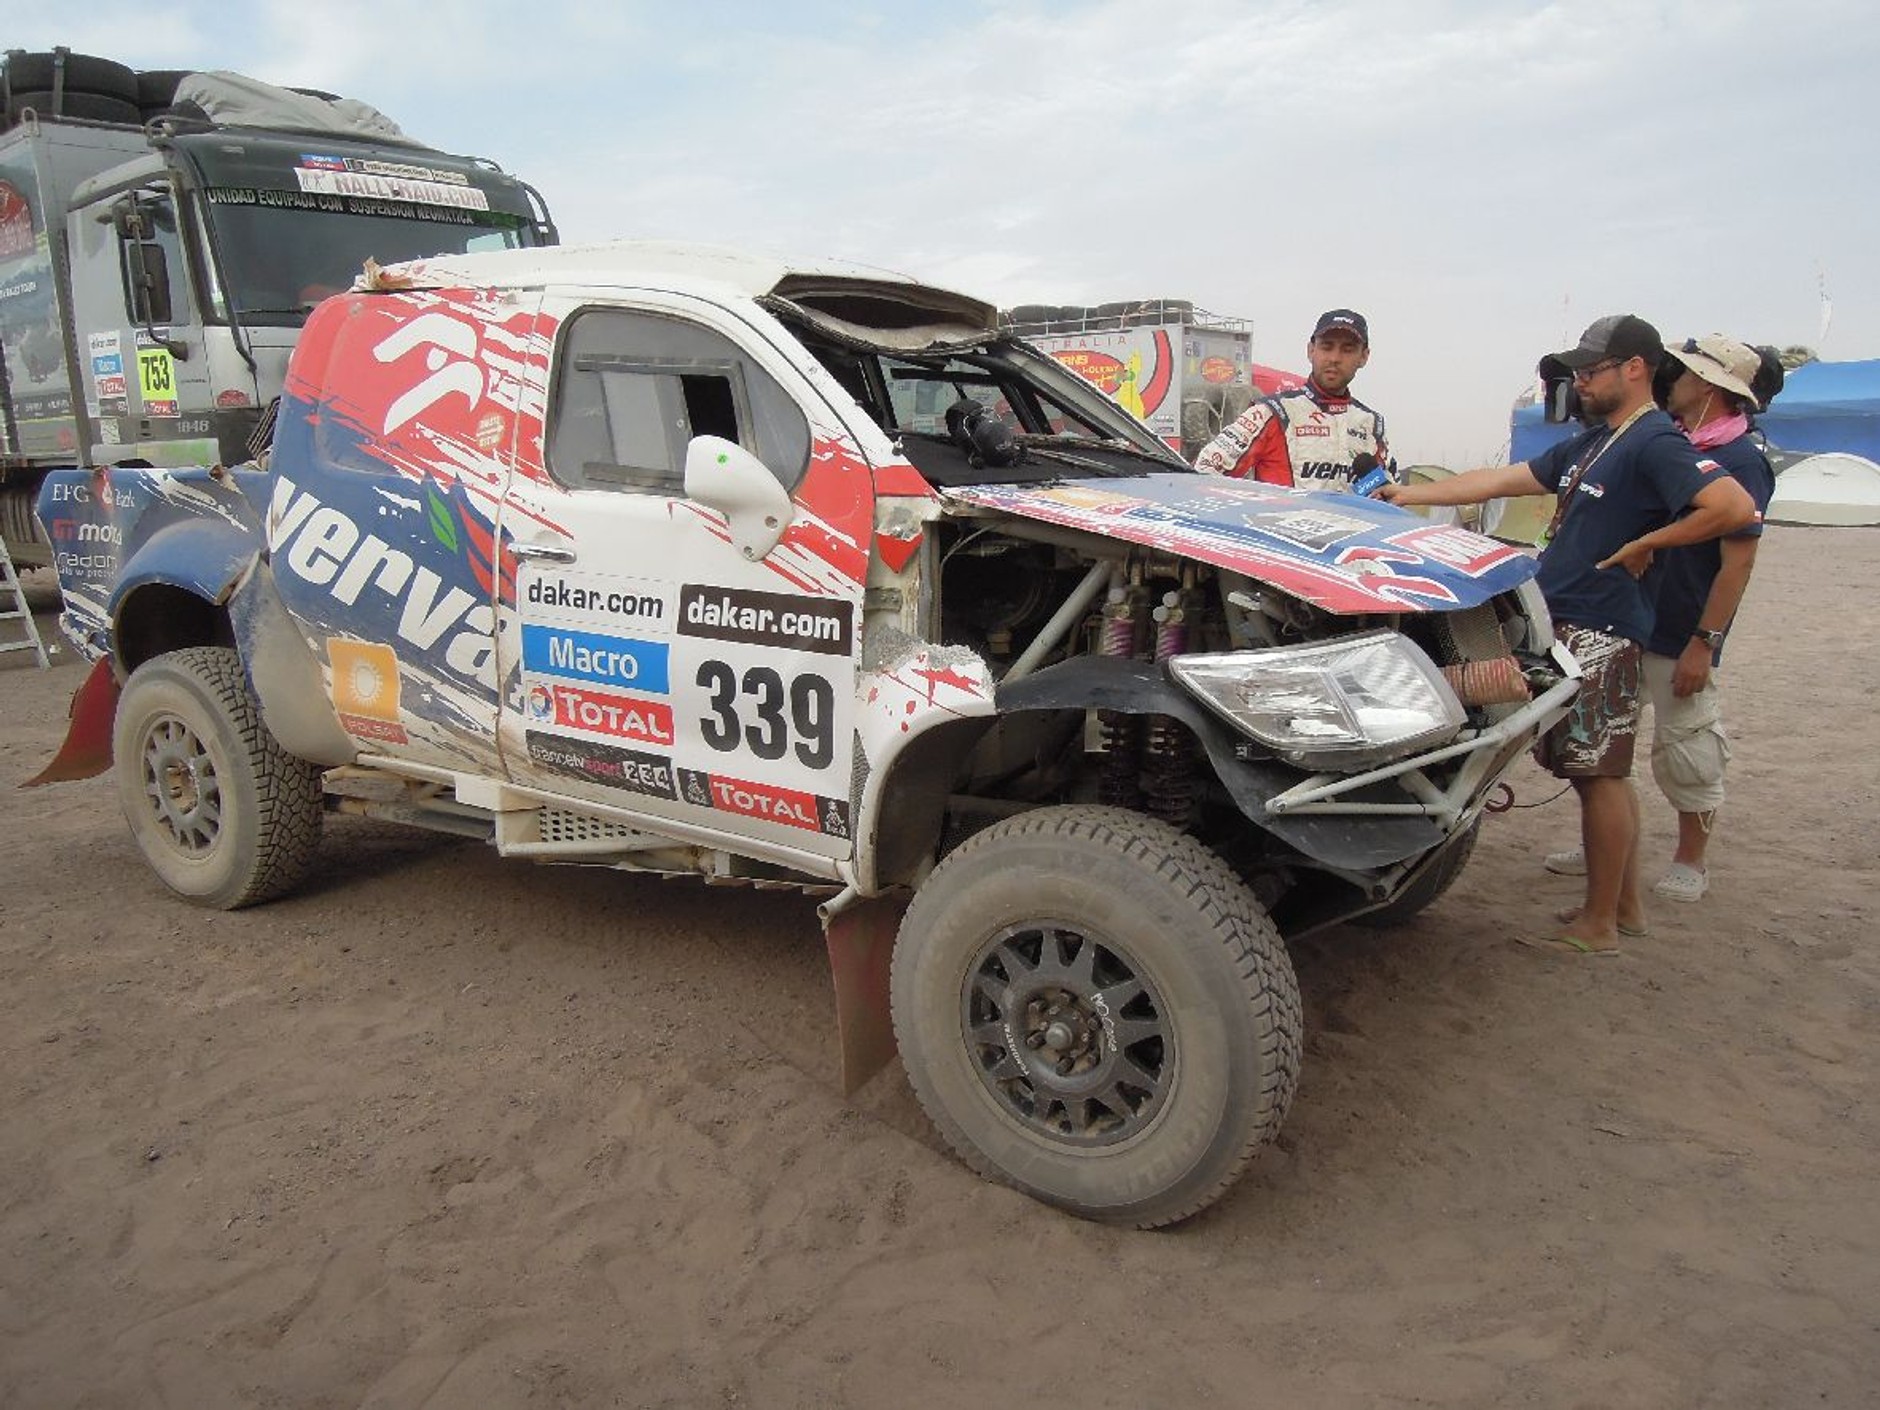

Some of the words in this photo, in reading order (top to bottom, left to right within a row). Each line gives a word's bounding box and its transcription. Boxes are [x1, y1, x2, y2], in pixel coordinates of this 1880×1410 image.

[207, 188, 255, 203] UNIDAD
[259, 190, 316, 208] EQUIPADA
[319, 197, 343, 211] CON
[141, 355, 170, 391] 753
[52, 483, 89, 502] EFG
[265, 475, 519, 693] verva
[528, 577, 663, 618] dakar.com
[687, 594, 841, 641] dakar.com
[549, 636, 639, 680] Macro
[563, 689, 670, 739] TOTAL
[696, 659, 835, 770] 339
[713, 781, 815, 825] TOTAL
